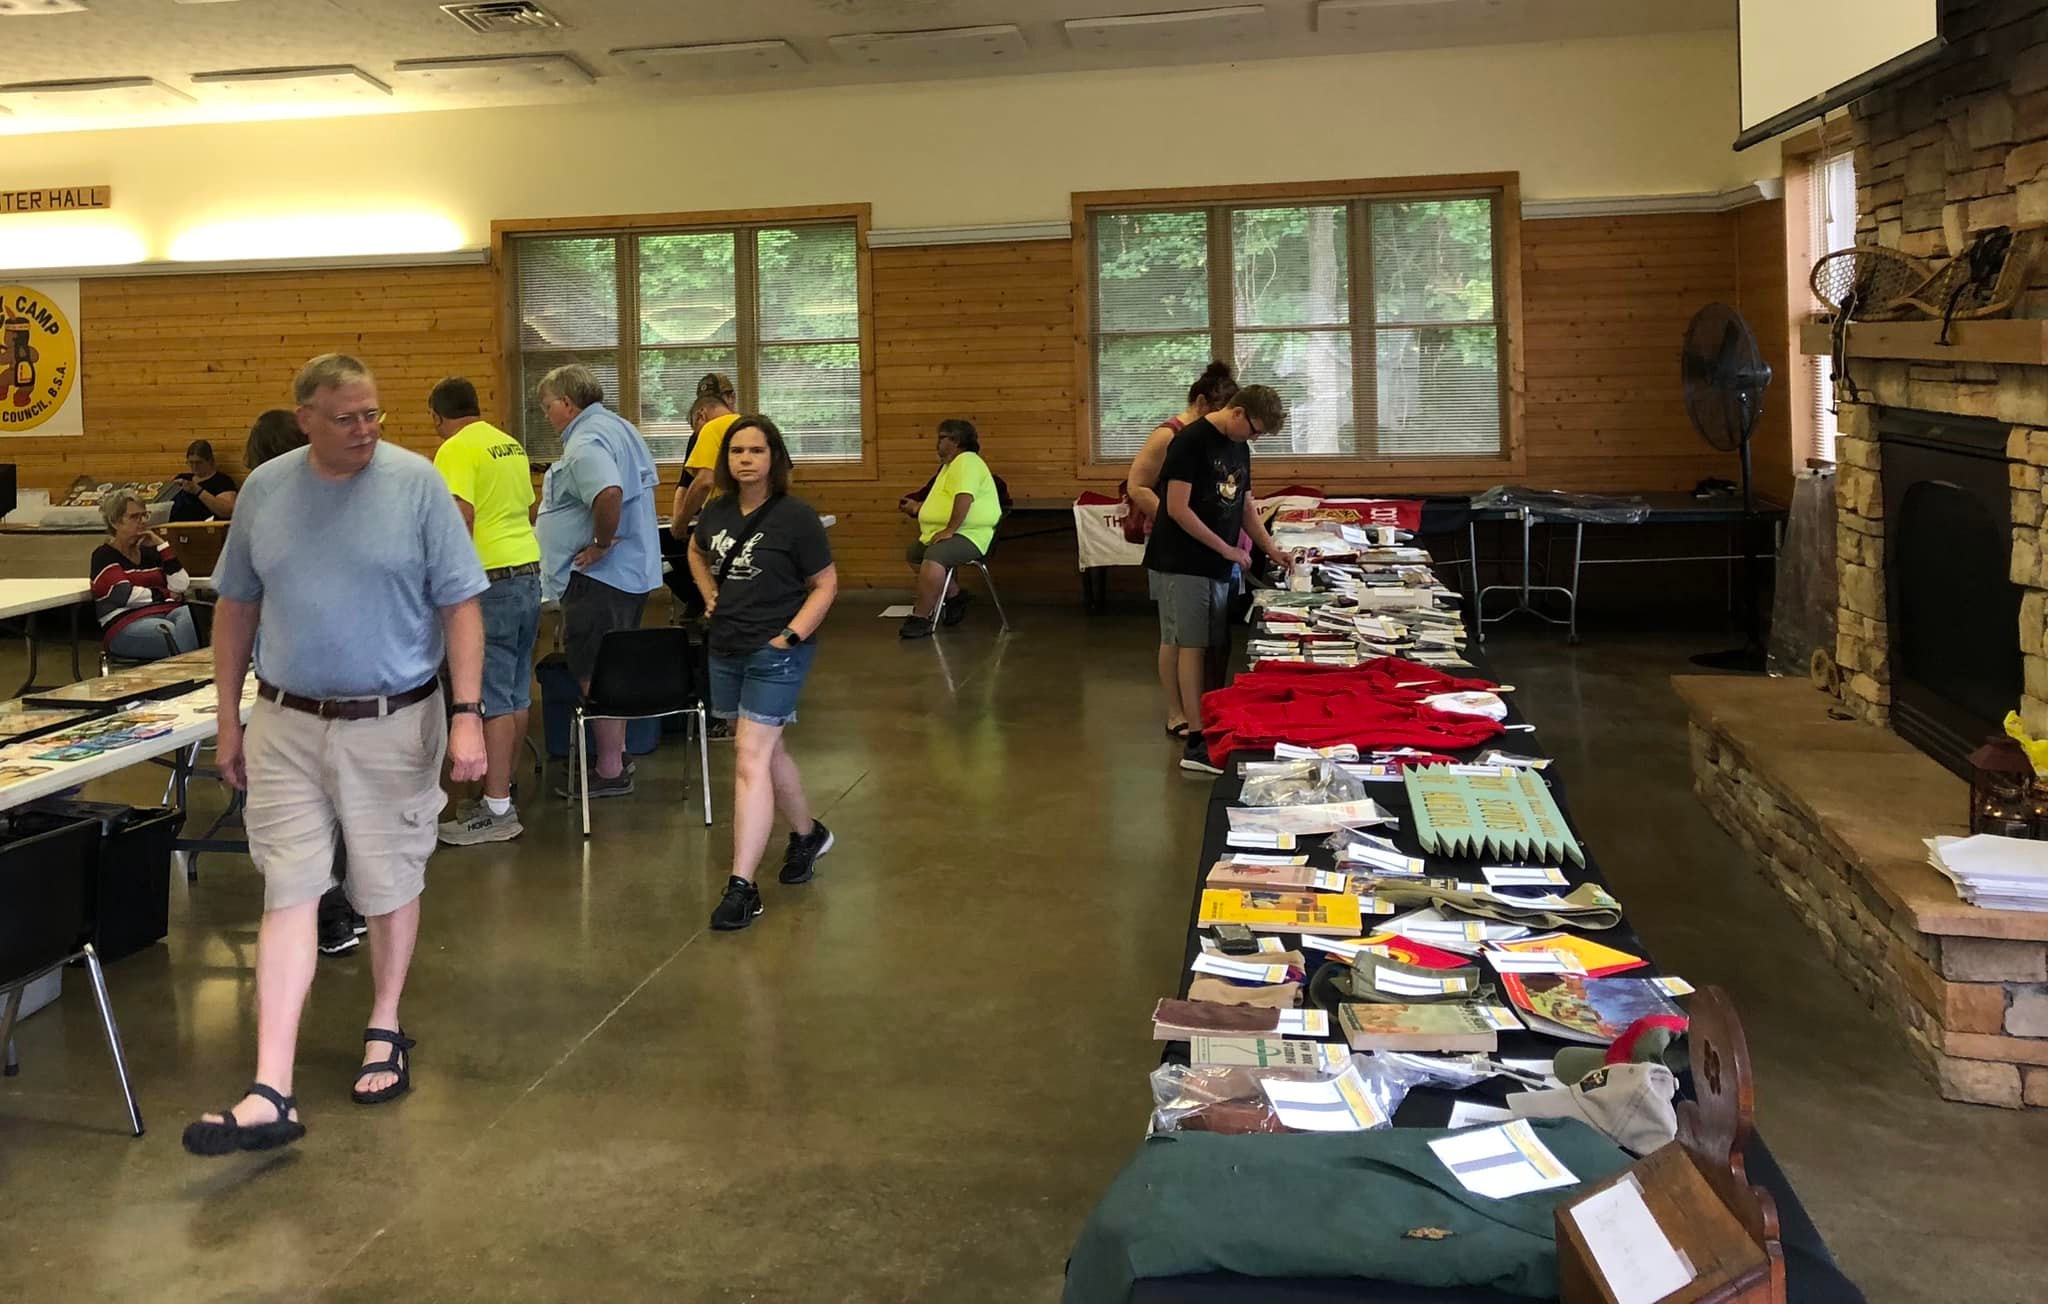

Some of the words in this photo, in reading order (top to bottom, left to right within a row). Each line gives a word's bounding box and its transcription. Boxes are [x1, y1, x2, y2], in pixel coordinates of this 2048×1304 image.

[0, 191, 42, 211] TER
[49, 188, 104, 208] HALL
[15, 295, 60, 335] CAMP
